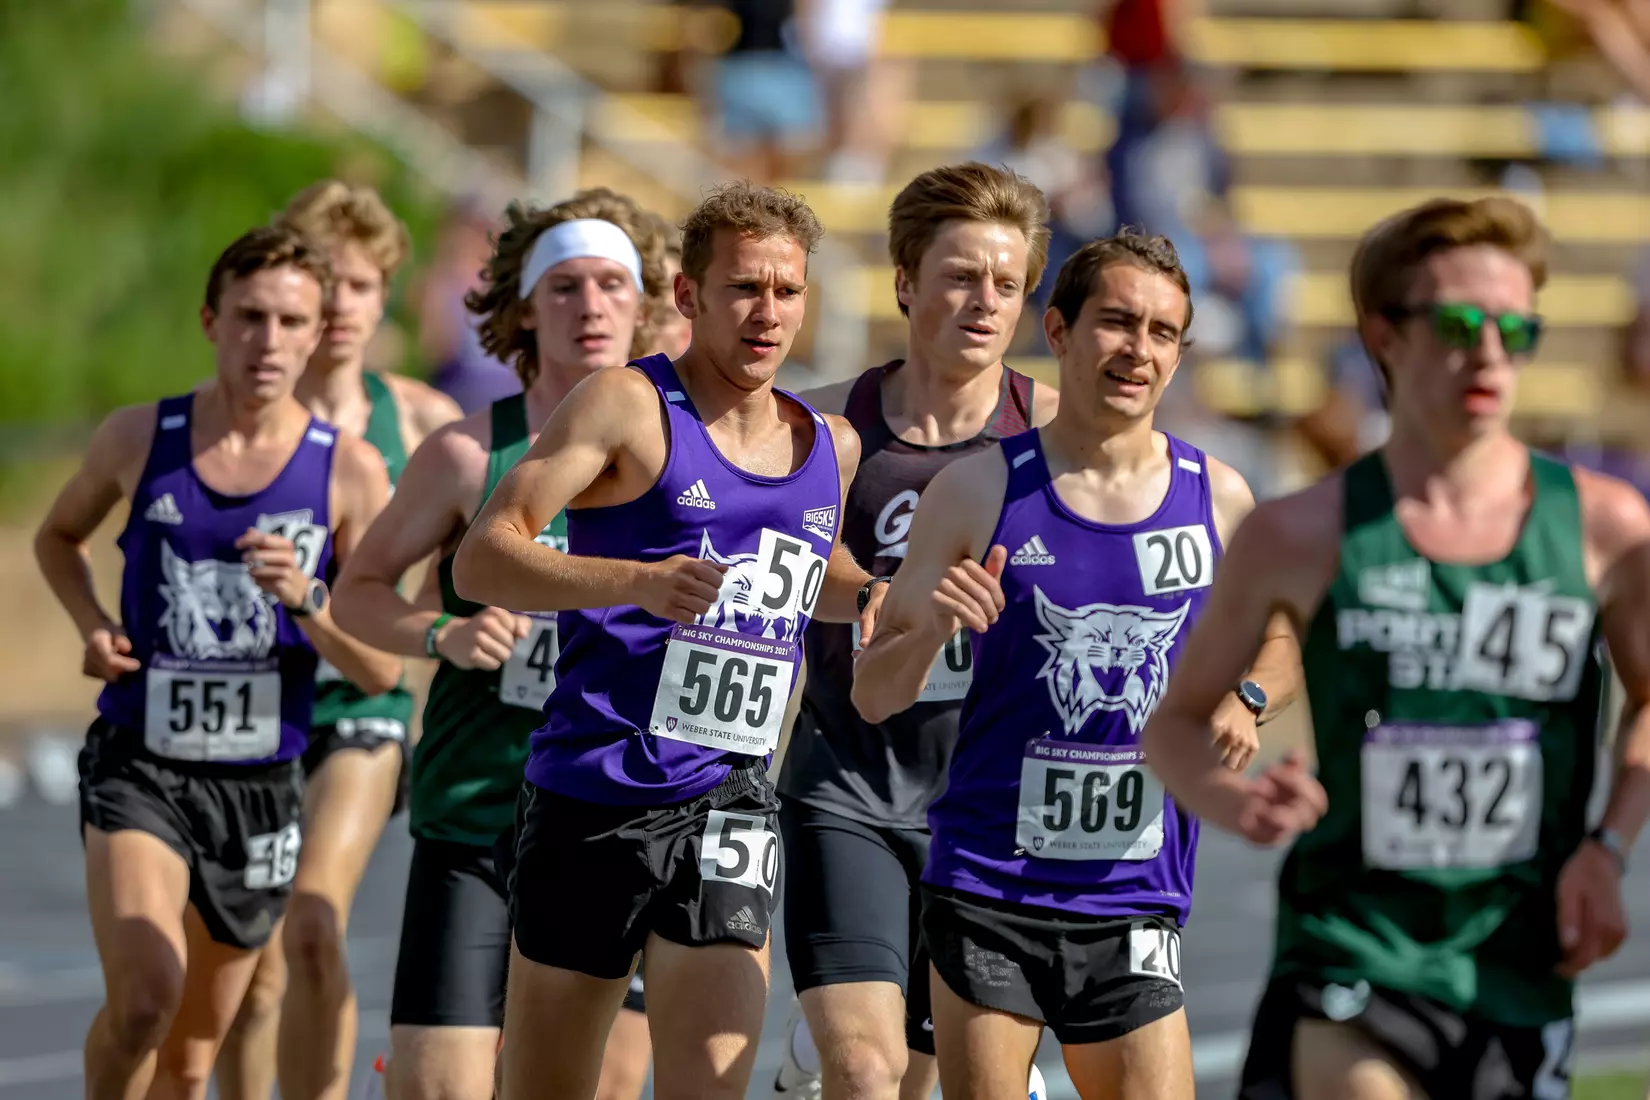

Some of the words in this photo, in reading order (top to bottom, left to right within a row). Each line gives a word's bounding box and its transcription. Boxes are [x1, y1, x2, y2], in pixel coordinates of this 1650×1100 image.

[677, 495, 716, 510] adidas
[761, 537, 823, 612] 50
[1010, 554, 1056, 566] adidas
[1147, 531, 1202, 589] 20
[682, 629, 697, 638] BIG
[698, 632, 713, 641] SKY
[715, 635, 774, 654] CHAMPIONSHIPS
[774, 646, 788, 656] 2021
[1480, 604, 1577, 688] 45
[168, 679, 256, 732] 551
[678, 649, 777, 728] 565
[682, 723, 708, 736] WEBER
[709, 730, 731, 740] STATE
[732, 733, 767, 746] UNIVERSITY
[1035, 746, 1050, 755] BIG
[1051, 748, 1068, 758] SKY
[1069, 750, 1137, 761] CHAMPIONSHIPS
[1043, 767, 1144, 833] 569
[1397, 760, 1514, 829] 432
[715, 817, 777, 889] 50
[1049, 841, 1077, 850] WEBER
[1080, 842, 1100, 850] STATE
[1103, 840, 1147, 850] UNIVERSITY
[726, 920, 763, 935] adidas
[1142, 921, 1180, 981] 20
